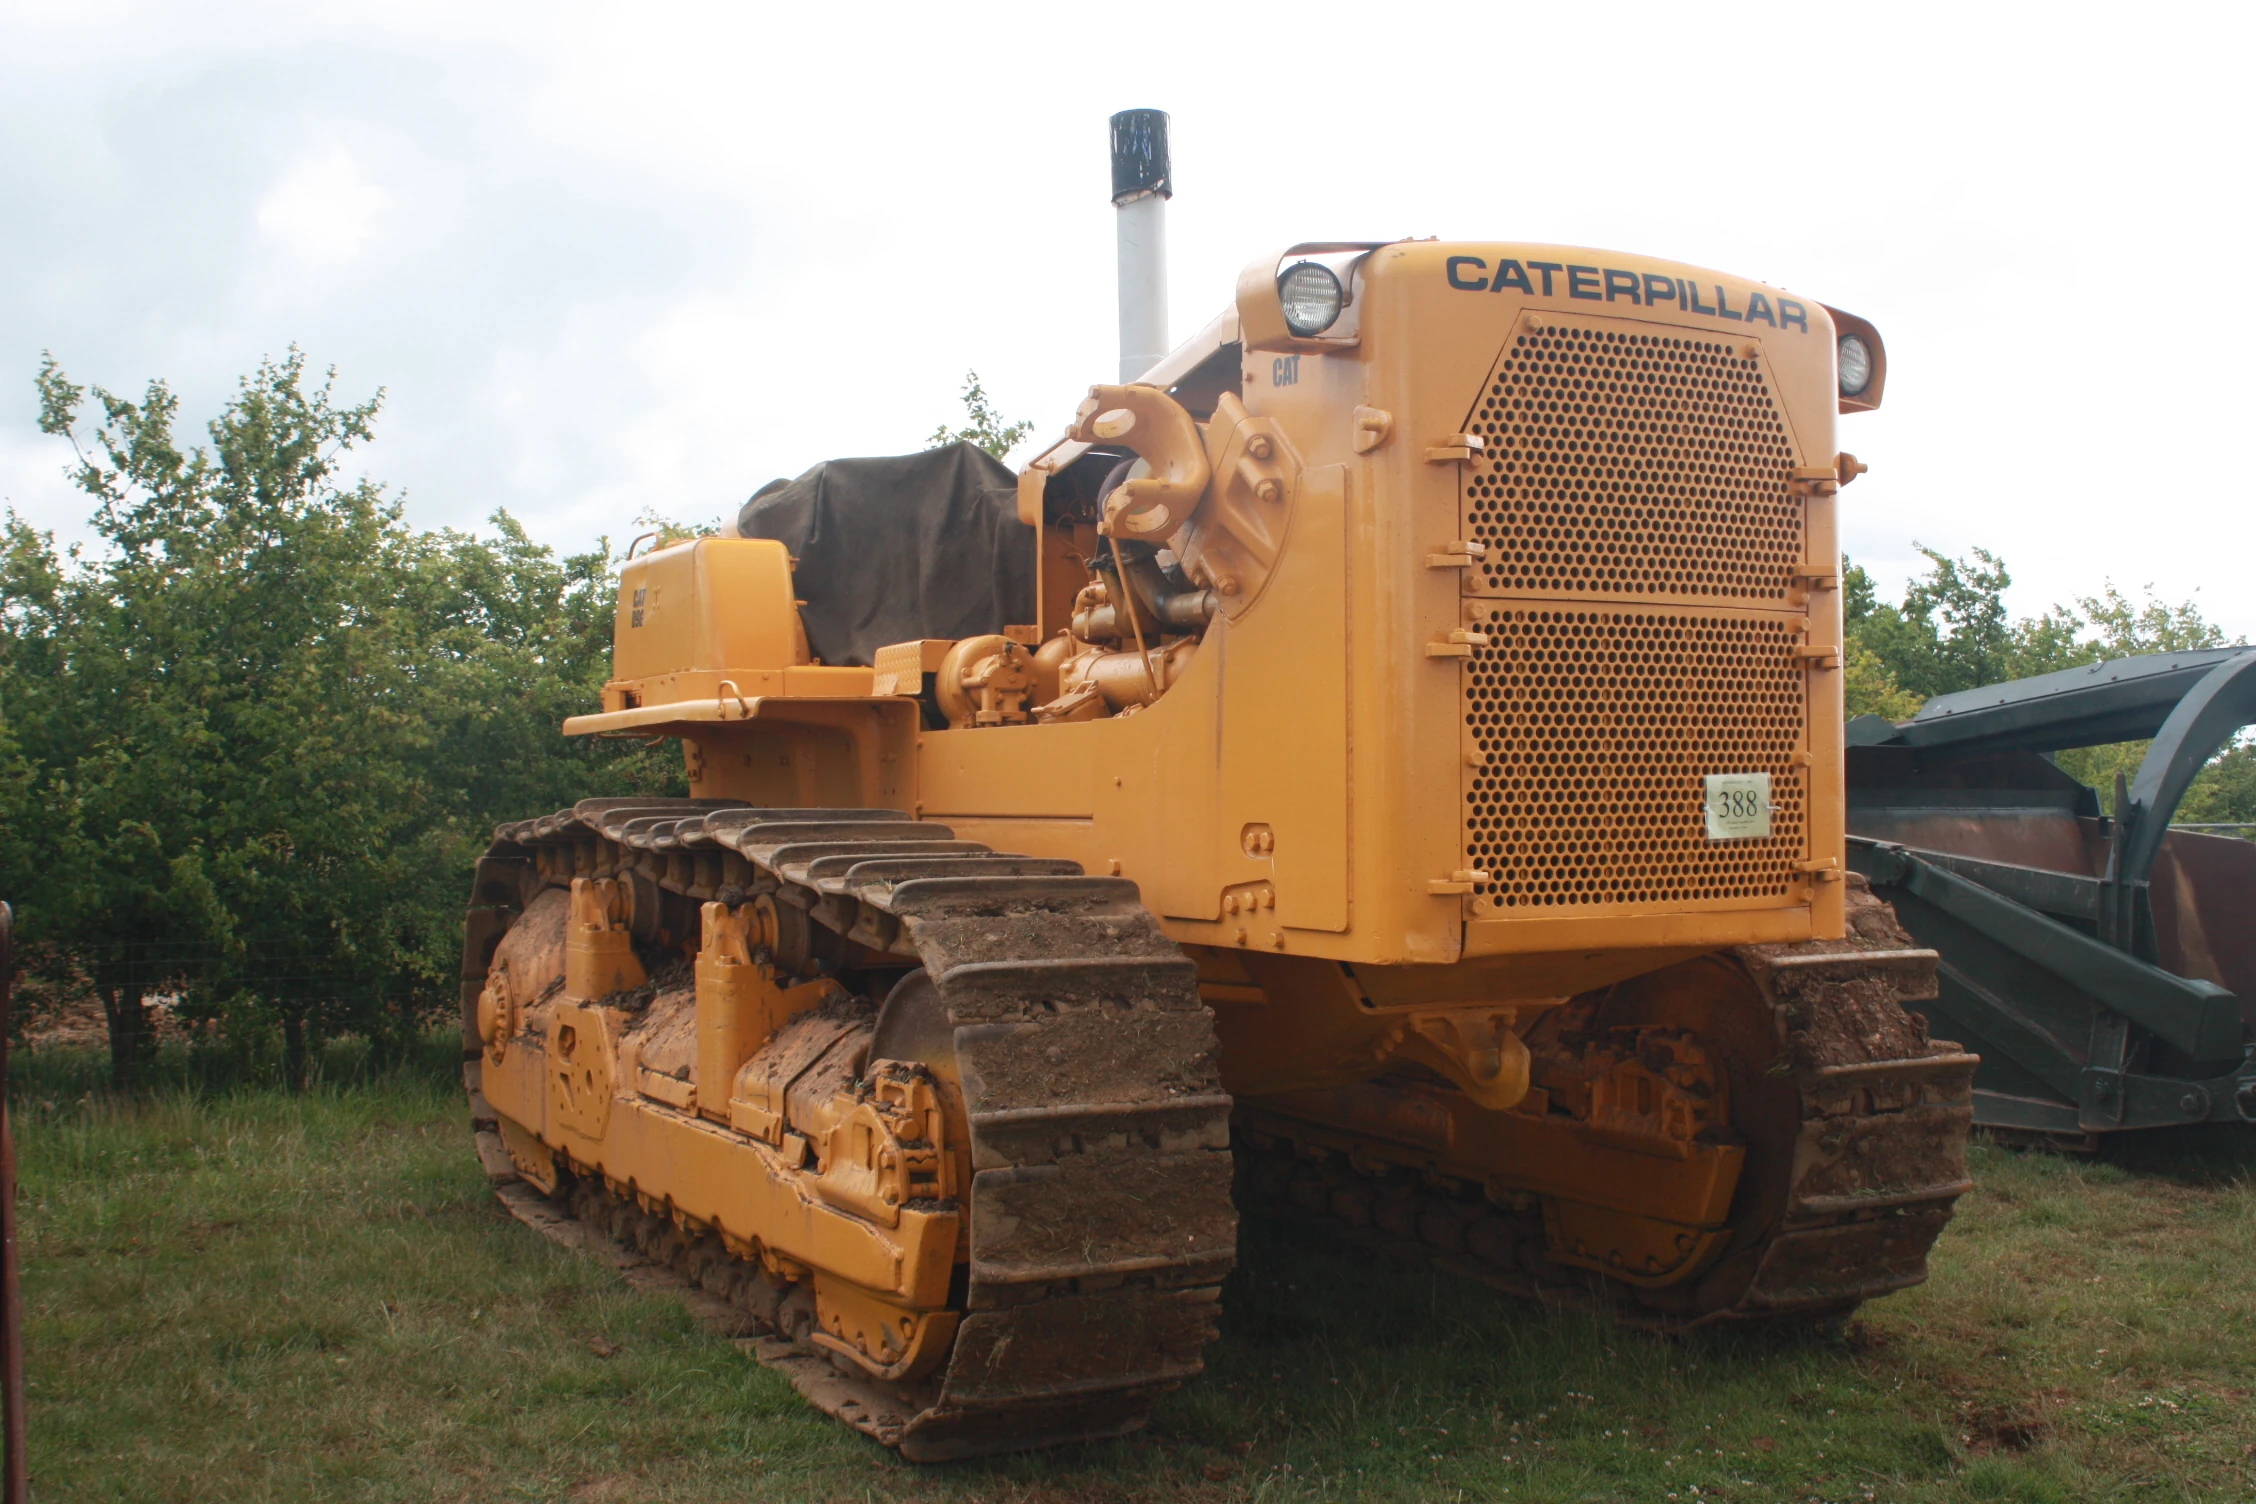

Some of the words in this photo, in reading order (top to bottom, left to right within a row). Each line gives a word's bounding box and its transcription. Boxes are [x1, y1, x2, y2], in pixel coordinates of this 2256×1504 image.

[1445, 255, 1808, 334] CATERPILLAR
[1272, 354, 1300, 388] CAT
[1718, 790, 1758, 818] 388
